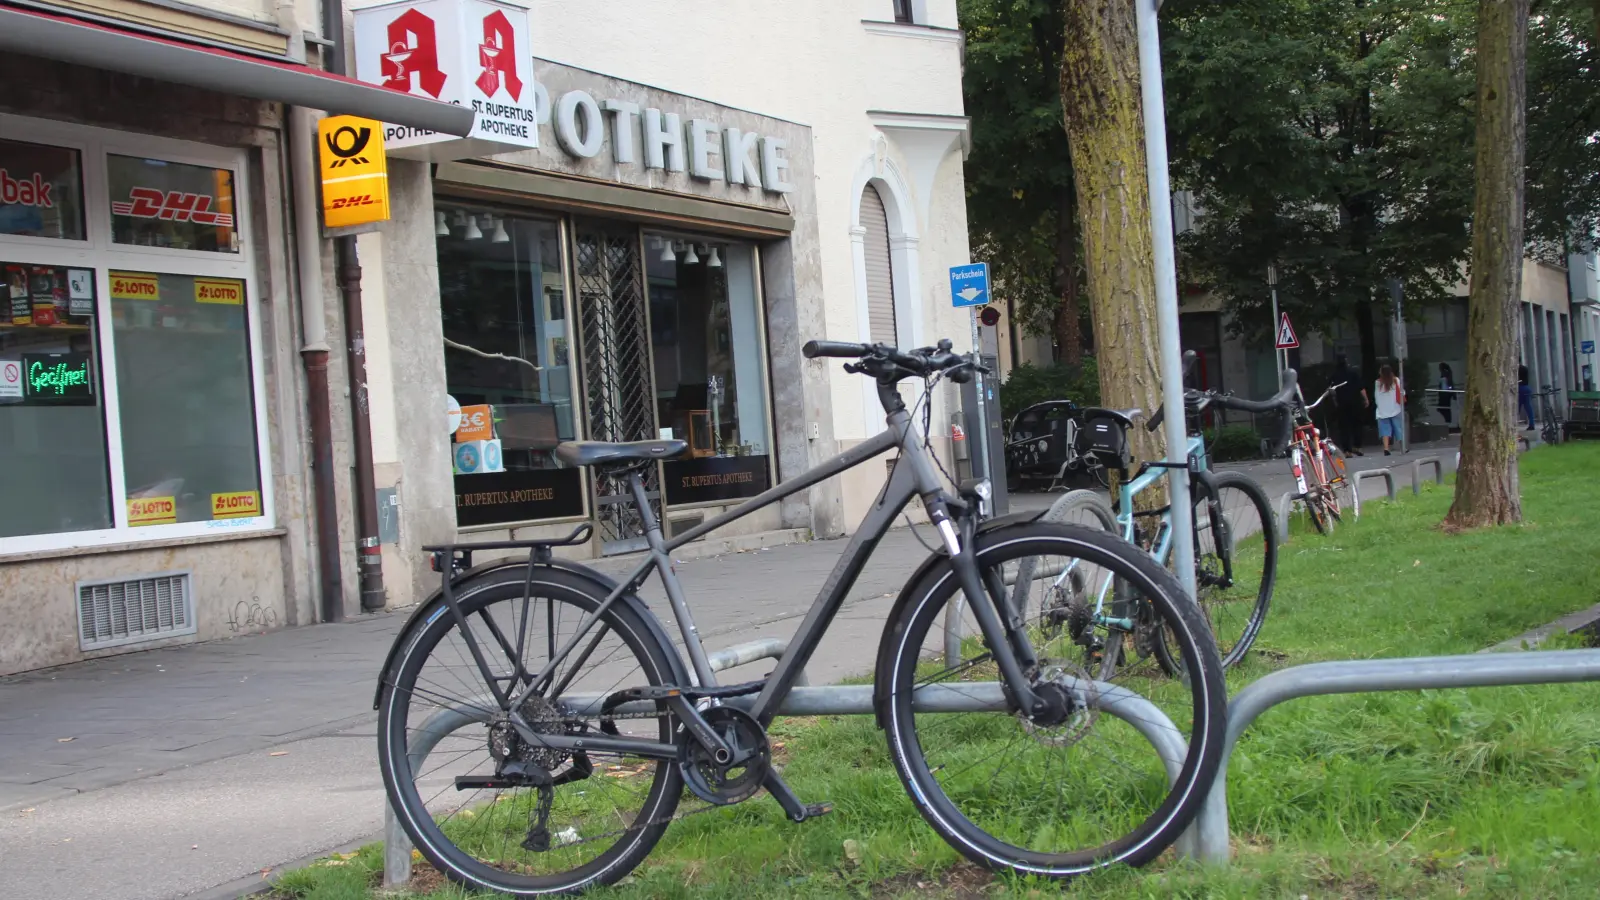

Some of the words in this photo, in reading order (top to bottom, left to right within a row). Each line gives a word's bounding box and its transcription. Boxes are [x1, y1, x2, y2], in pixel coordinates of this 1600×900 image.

[472, 99, 484, 114] ST.
[485, 102, 534, 122] RUPERTUS
[481, 118, 529, 139] APOTHEKE
[129, 186, 219, 225] DHL
[332, 194, 374, 210] DHL
[951, 269, 984, 281] Parkschein
[125, 281, 156, 296] LOTTO
[209, 286, 237, 300] LOTTO
[681, 476, 691, 488] ST.
[691, 474, 722, 487] RUPERTUS
[722, 471, 753, 484] APOTHEKE
[227, 495, 253, 508] LOTTO
[455, 494, 463, 507] T.
[464, 490, 508, 507] RUPERTUS
[509, 487, 554, 503] APOTHEKE
[142, 500, 173, 514] LOTTO
